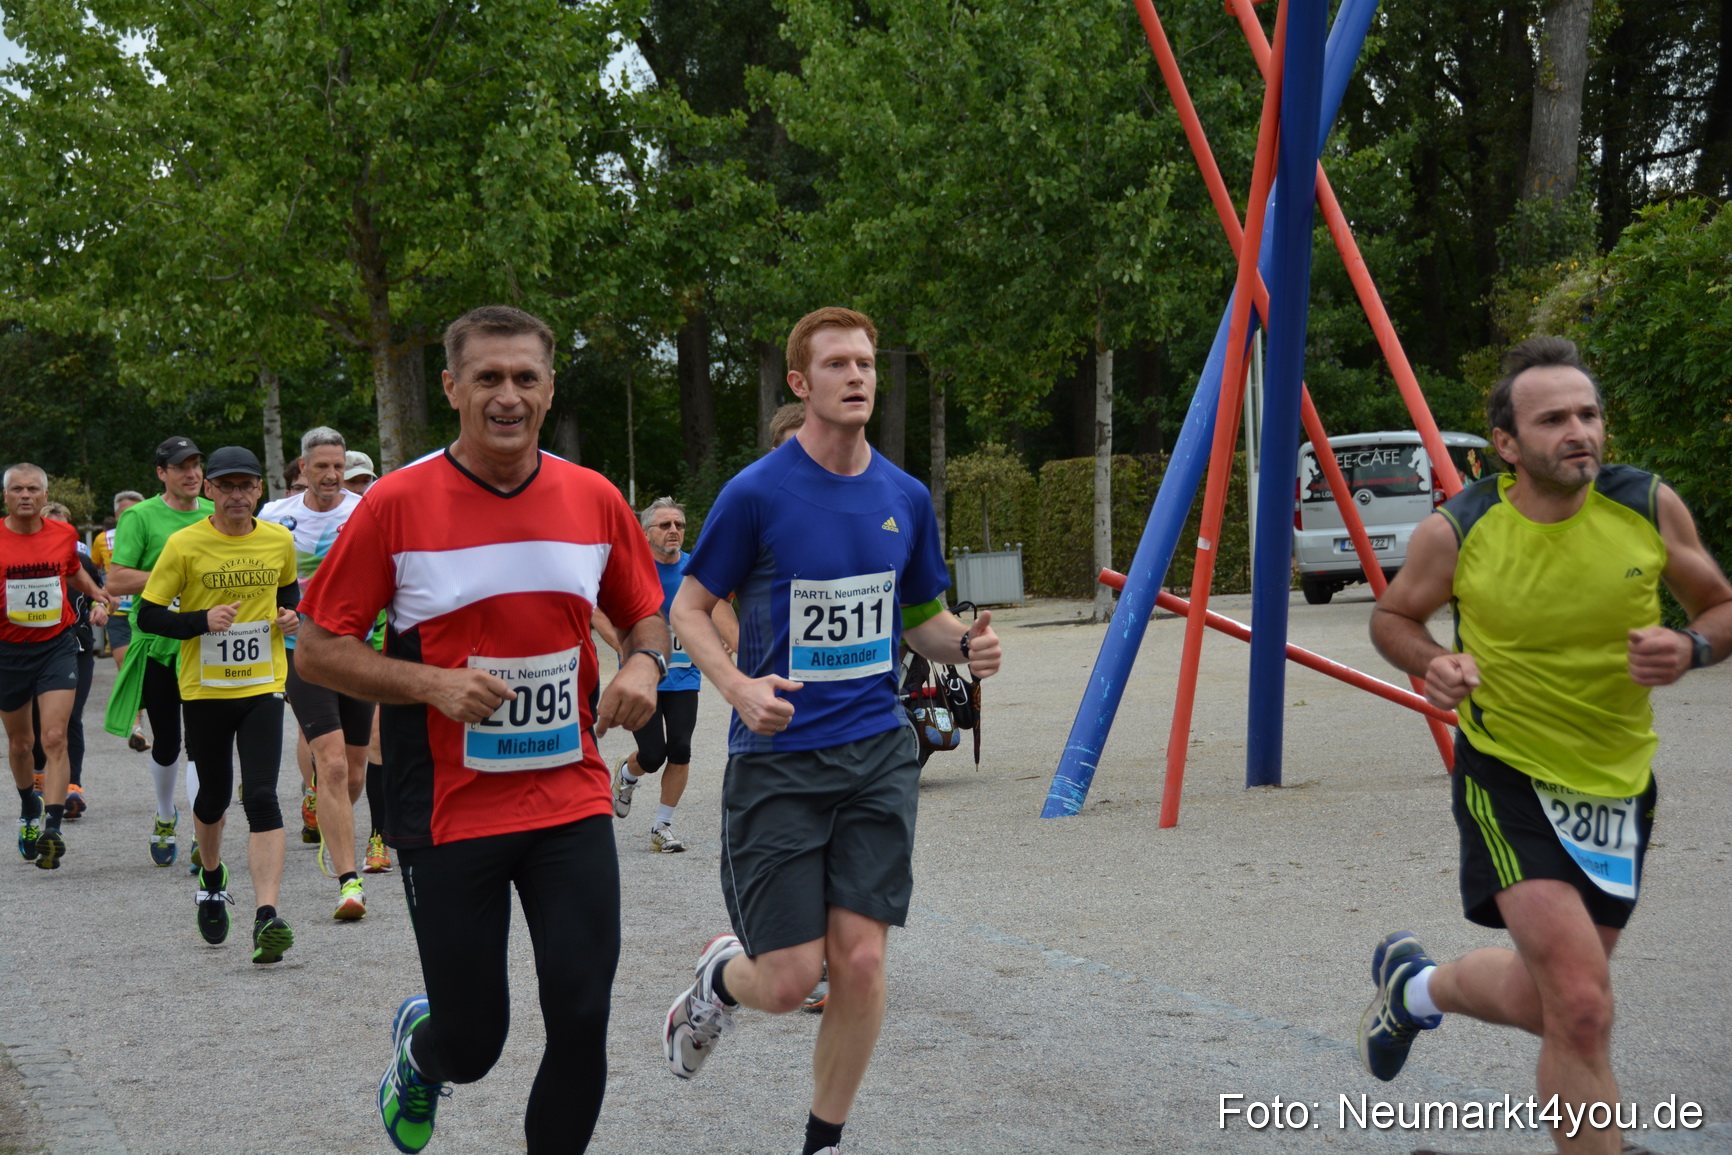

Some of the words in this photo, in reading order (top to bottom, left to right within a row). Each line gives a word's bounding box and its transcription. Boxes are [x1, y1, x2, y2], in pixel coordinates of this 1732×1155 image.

[221, 558, 265, 572] PIZZERIA
[212, 570, 274, 587] FRANCESCO
[26, 590, 48, 608] 48
[224, 587, 266, 599] HERSBRUCK
[794, 590, 832, 600] PARTL
[835, 585, 880, 599] Neumarkt
[803, 598, 882, 642] 2511
[228, 628, 261, 636] Neumarkt
[217, 638, 260, 662] 186
[811, 648, 877, 666] Alexander
[225, 667, 252, 678] Bernd
[518, 664, 566, 680] Neumarkt
[497, 734, 560, 755] Michael
[1551, 798, 1626, 849] 2807
